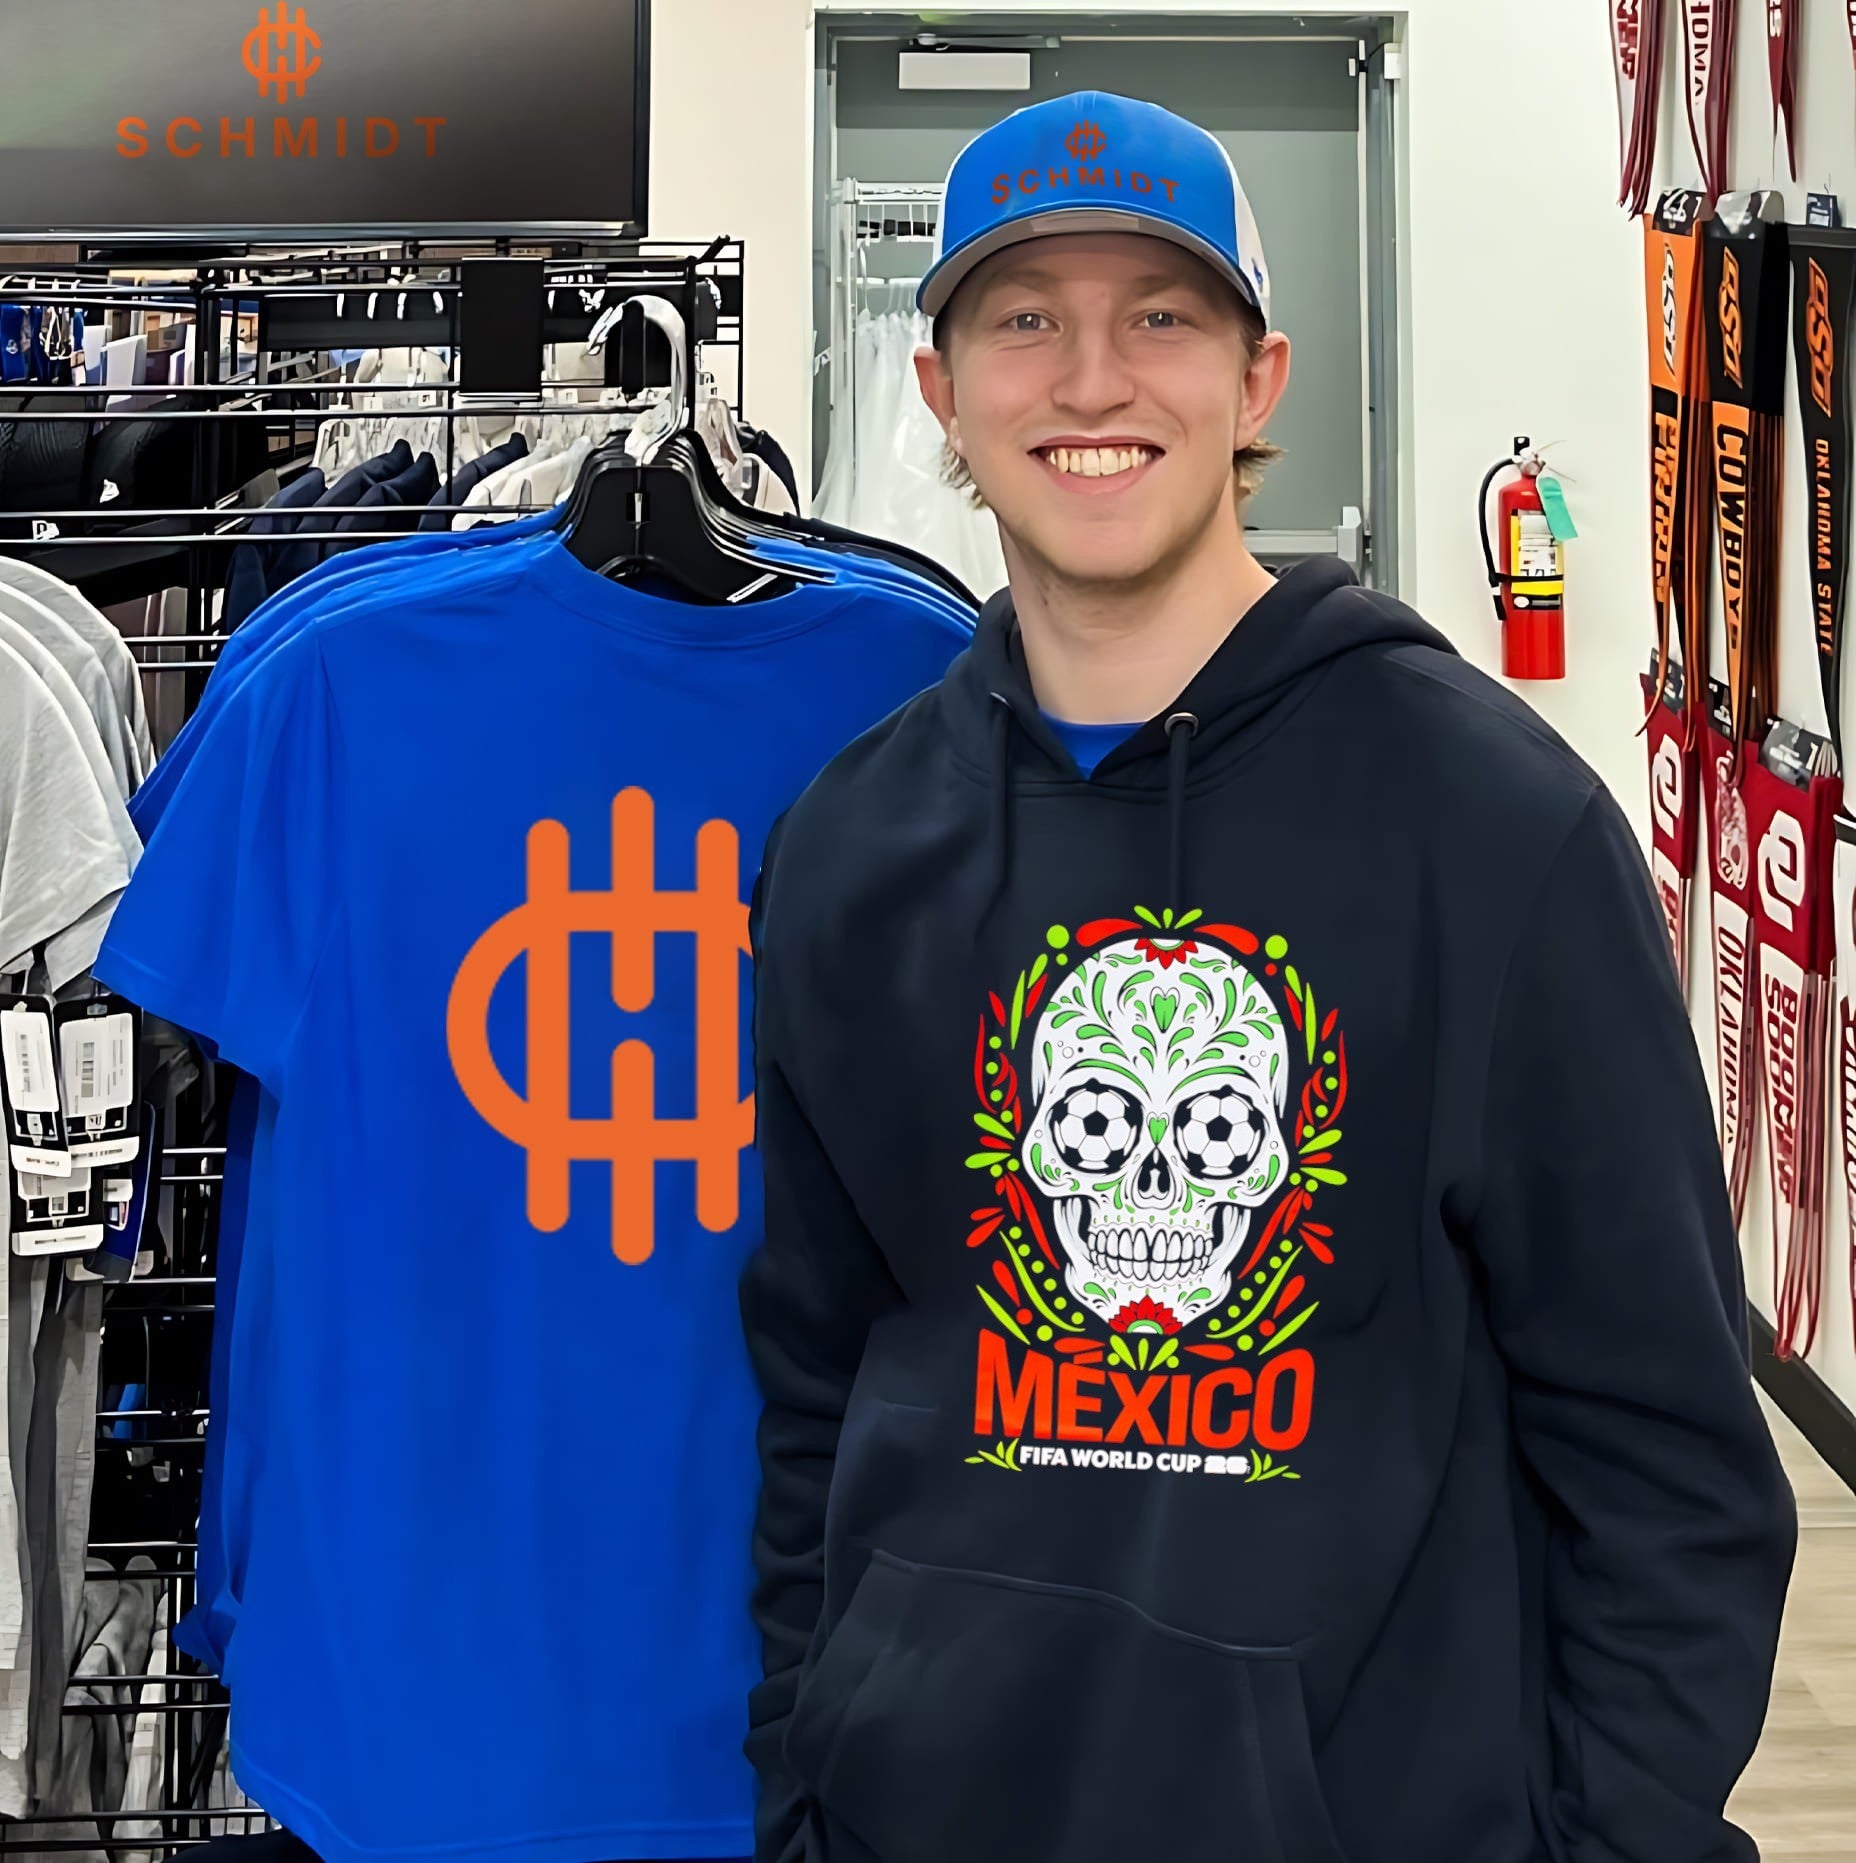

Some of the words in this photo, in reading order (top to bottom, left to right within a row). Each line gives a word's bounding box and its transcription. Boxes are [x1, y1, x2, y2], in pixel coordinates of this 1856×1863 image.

[115, 116, 448, 158] SCHMIDT
[991, 166, 1179, 205] SCHMIDT
[1716, 424, 1749, 649] COWBOY
[974, 1328, 1315, 1451] MÉXICO
[1020, 1446, 1068, 1467] FIFA
[1071, 1448, 1153, 1472] WORLD
[1156, 1452, 1202, 1473] CUP
